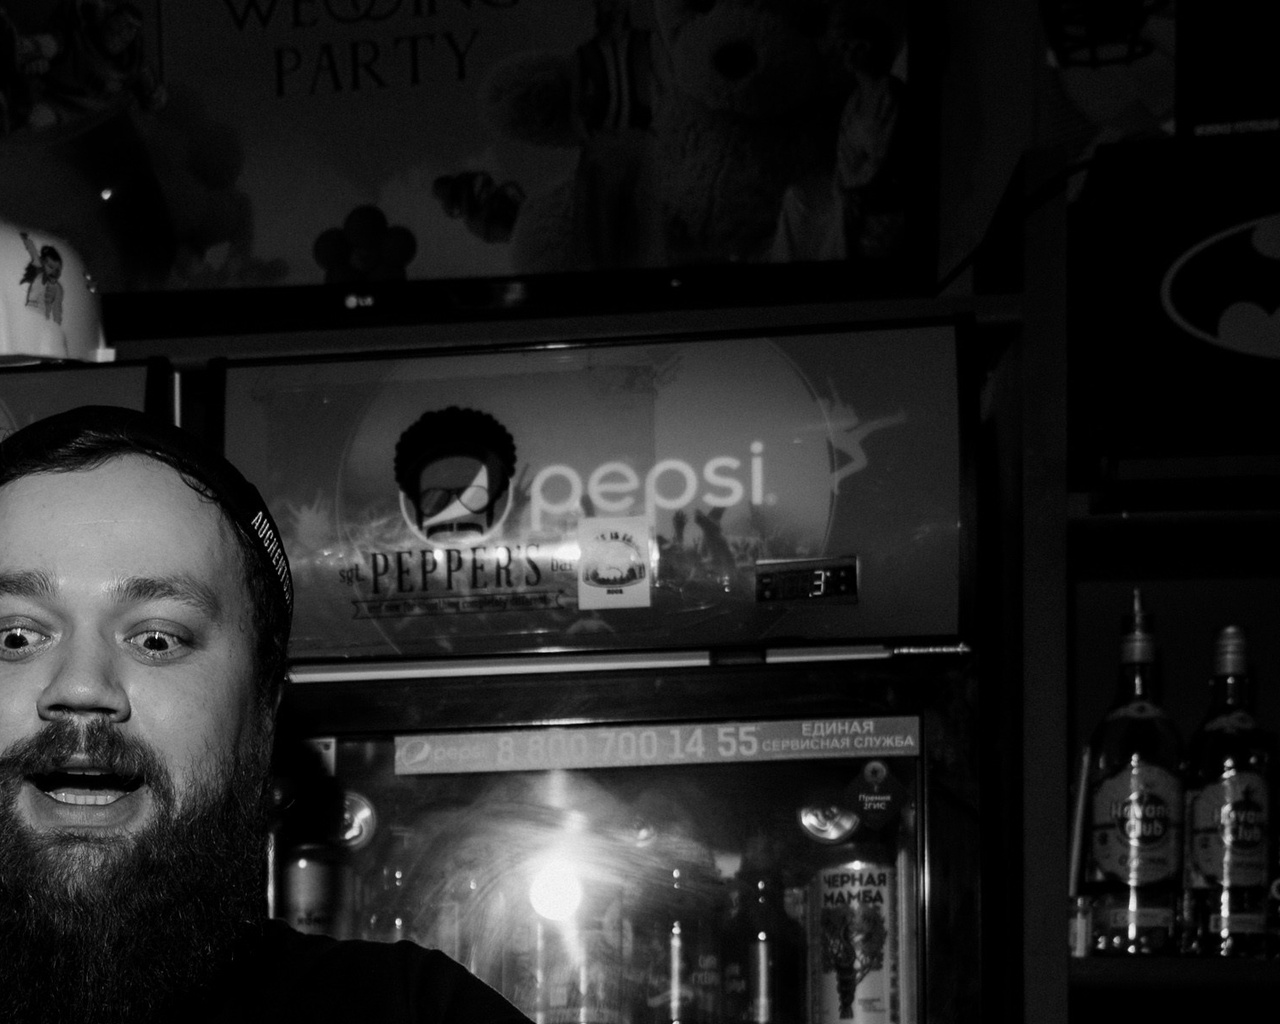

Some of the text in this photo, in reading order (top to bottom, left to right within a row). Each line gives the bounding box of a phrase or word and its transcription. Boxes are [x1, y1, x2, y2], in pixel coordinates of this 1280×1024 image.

[273, 28, 480, 98] PARTY
[528, 441, 767, 530] pepsi
[370, 543, 543, 596] PEPPER'S
[761, 734, 915, 752] СЕРВИСНАЯ СЛУЖБА
[801, 720, 875, 737] ЕДИНАЯ
[496, 735, 515, 766] 8
[526, 732, 588, 764] 800
[600, 730, 660, 762] 700
[668, 728, 706, 759] 14
[717, 725, 759, 757] 55
[822, 872, 887, 889] ЧЕРНАЯ
[822, 889, 885, 906] МАМБА
